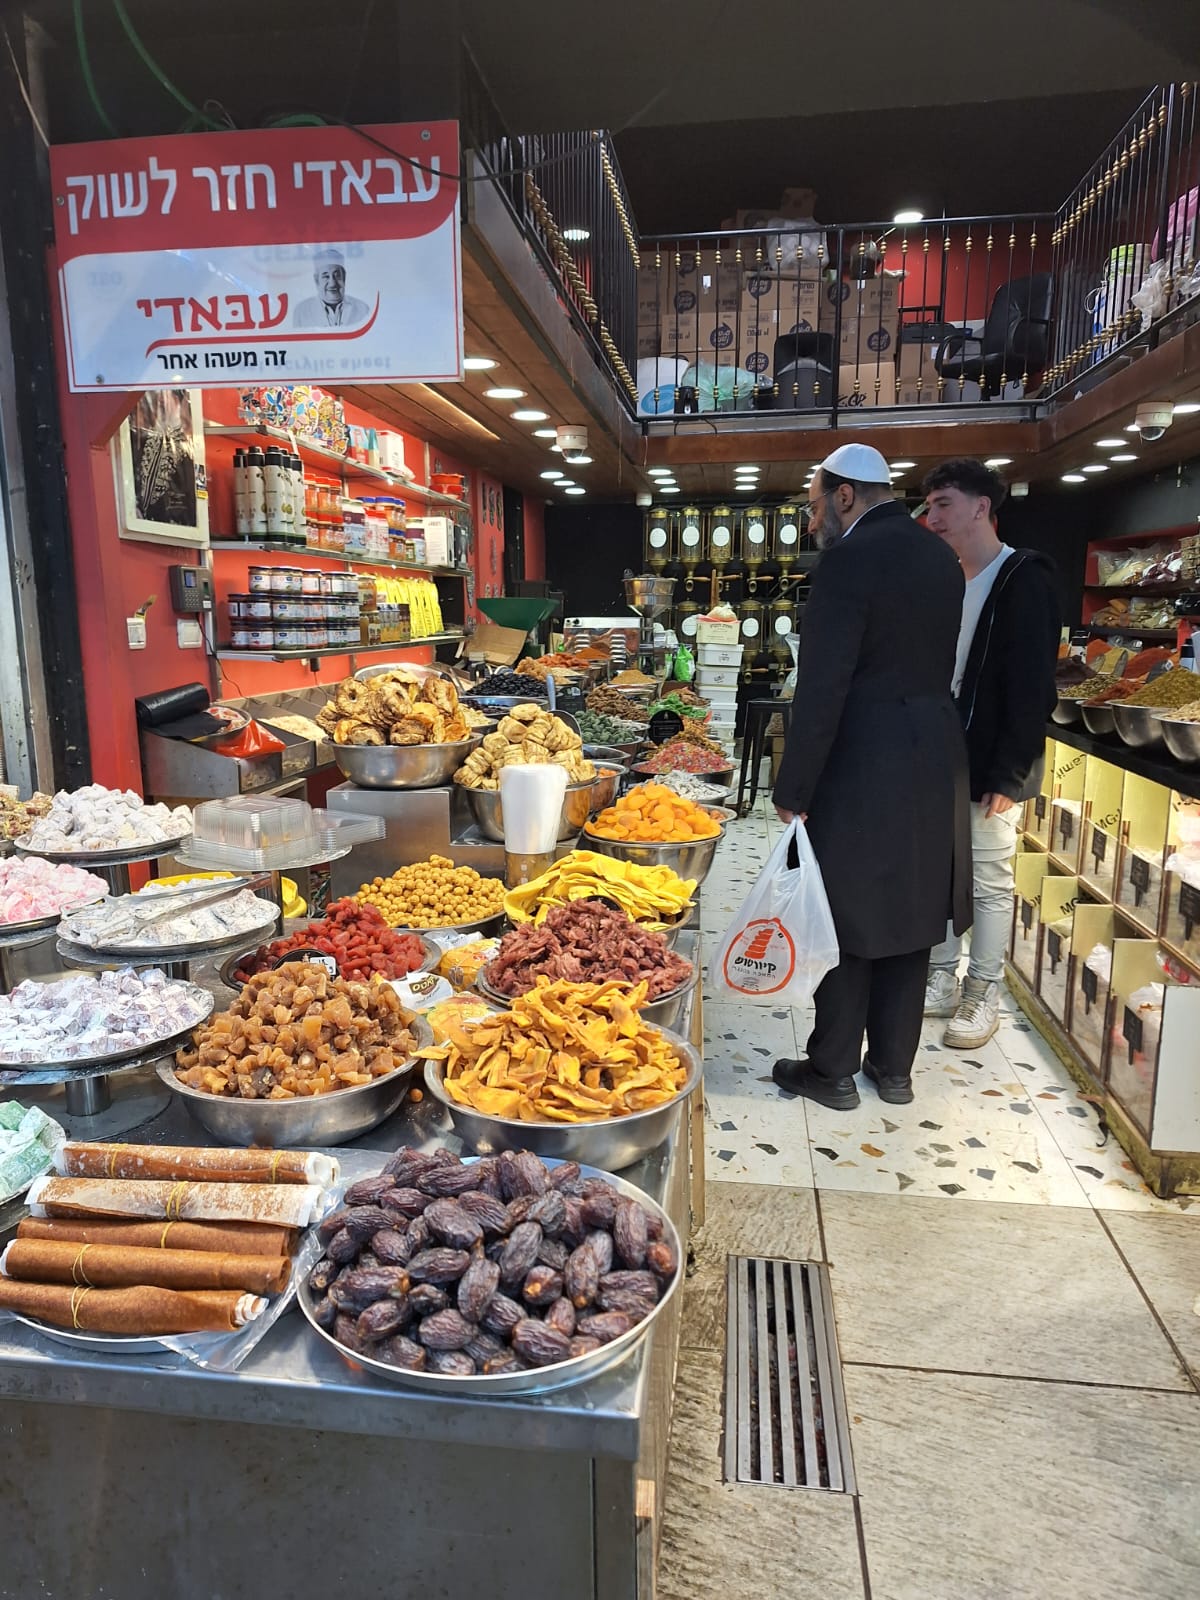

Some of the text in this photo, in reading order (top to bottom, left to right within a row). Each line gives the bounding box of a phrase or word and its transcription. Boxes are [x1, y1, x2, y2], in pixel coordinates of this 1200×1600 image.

[66, 156, 440, 235] עבאדי חזר לשוק
[156, 352, 199, 370] אחר
[204, 351, 258, 369] משהו
[264, 350, 287, 367] זה
